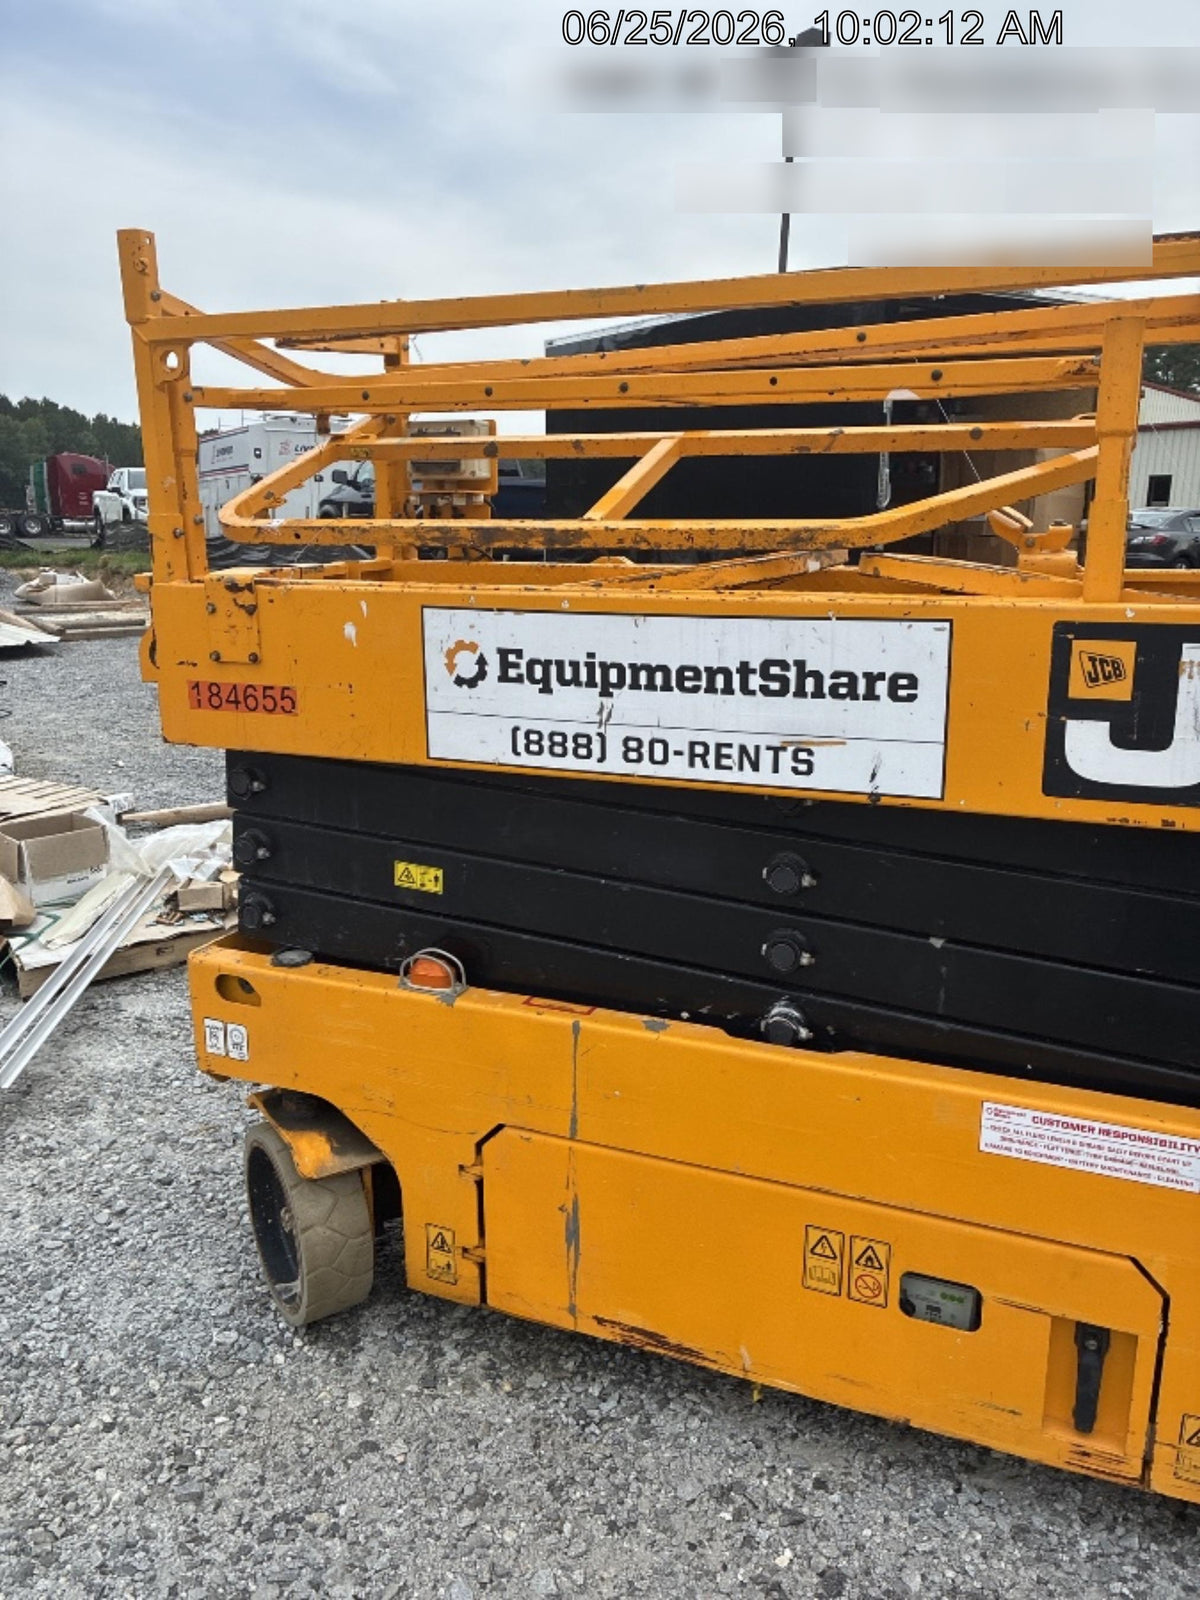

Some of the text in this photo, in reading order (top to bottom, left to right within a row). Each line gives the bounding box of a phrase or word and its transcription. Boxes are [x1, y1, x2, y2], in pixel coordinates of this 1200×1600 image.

[497, 647, 919, 703] EquipmentShare
[1086, 655, 1123, 684] JCB
[191, 681, 296, 714] 184655
[511, 725, 815, 777] (888) 80-RENTS
[1031, 1114, 1094, 1134] CUSTOMER
[1098, 1126, 1200, 1154] RESPONSIBILITY
